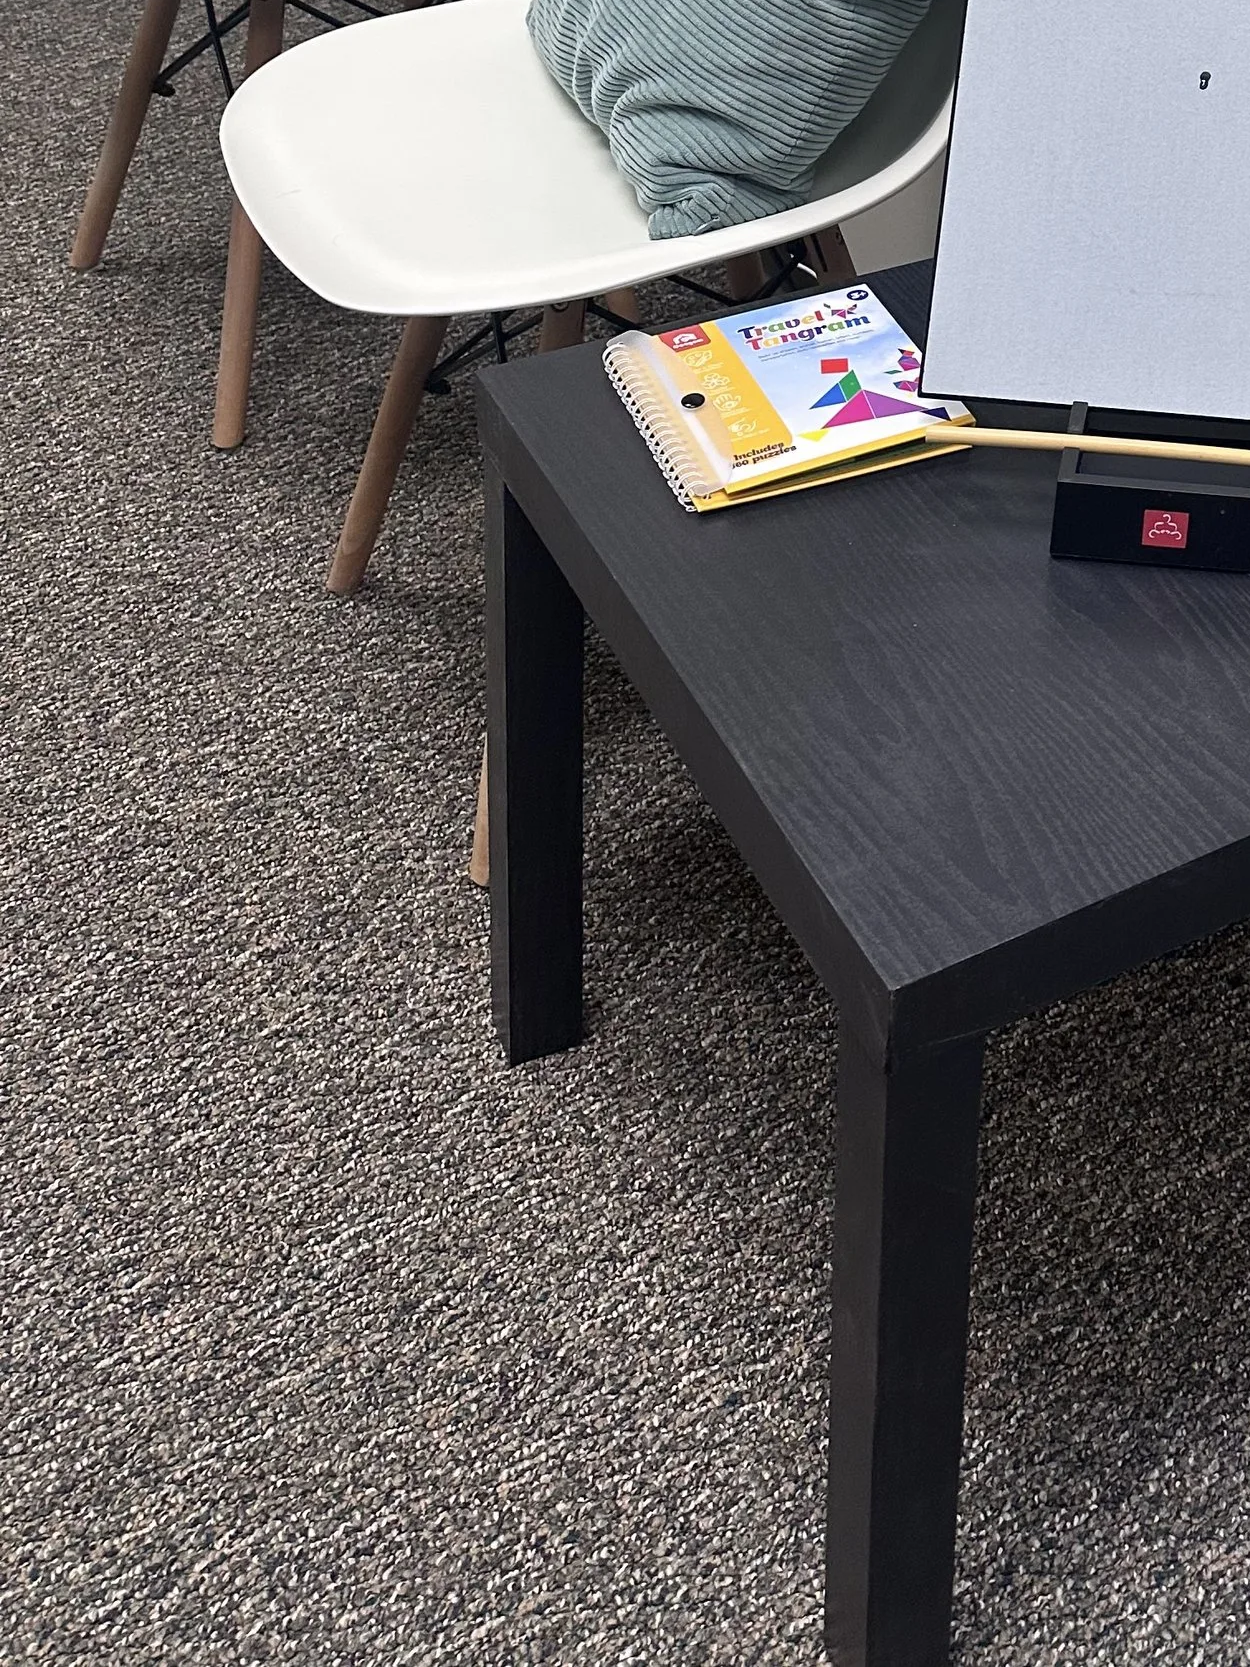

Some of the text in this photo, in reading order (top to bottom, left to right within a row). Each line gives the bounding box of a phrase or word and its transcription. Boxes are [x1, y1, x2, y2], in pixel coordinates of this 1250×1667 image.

[850, 290, 866, 300] 3+
[737, 310, 825, 339] Travel
[746, 315, 871, 350] Tangram
[733, 442, 784, 461] Includes
[752, 445, 797, 464] puzzles
